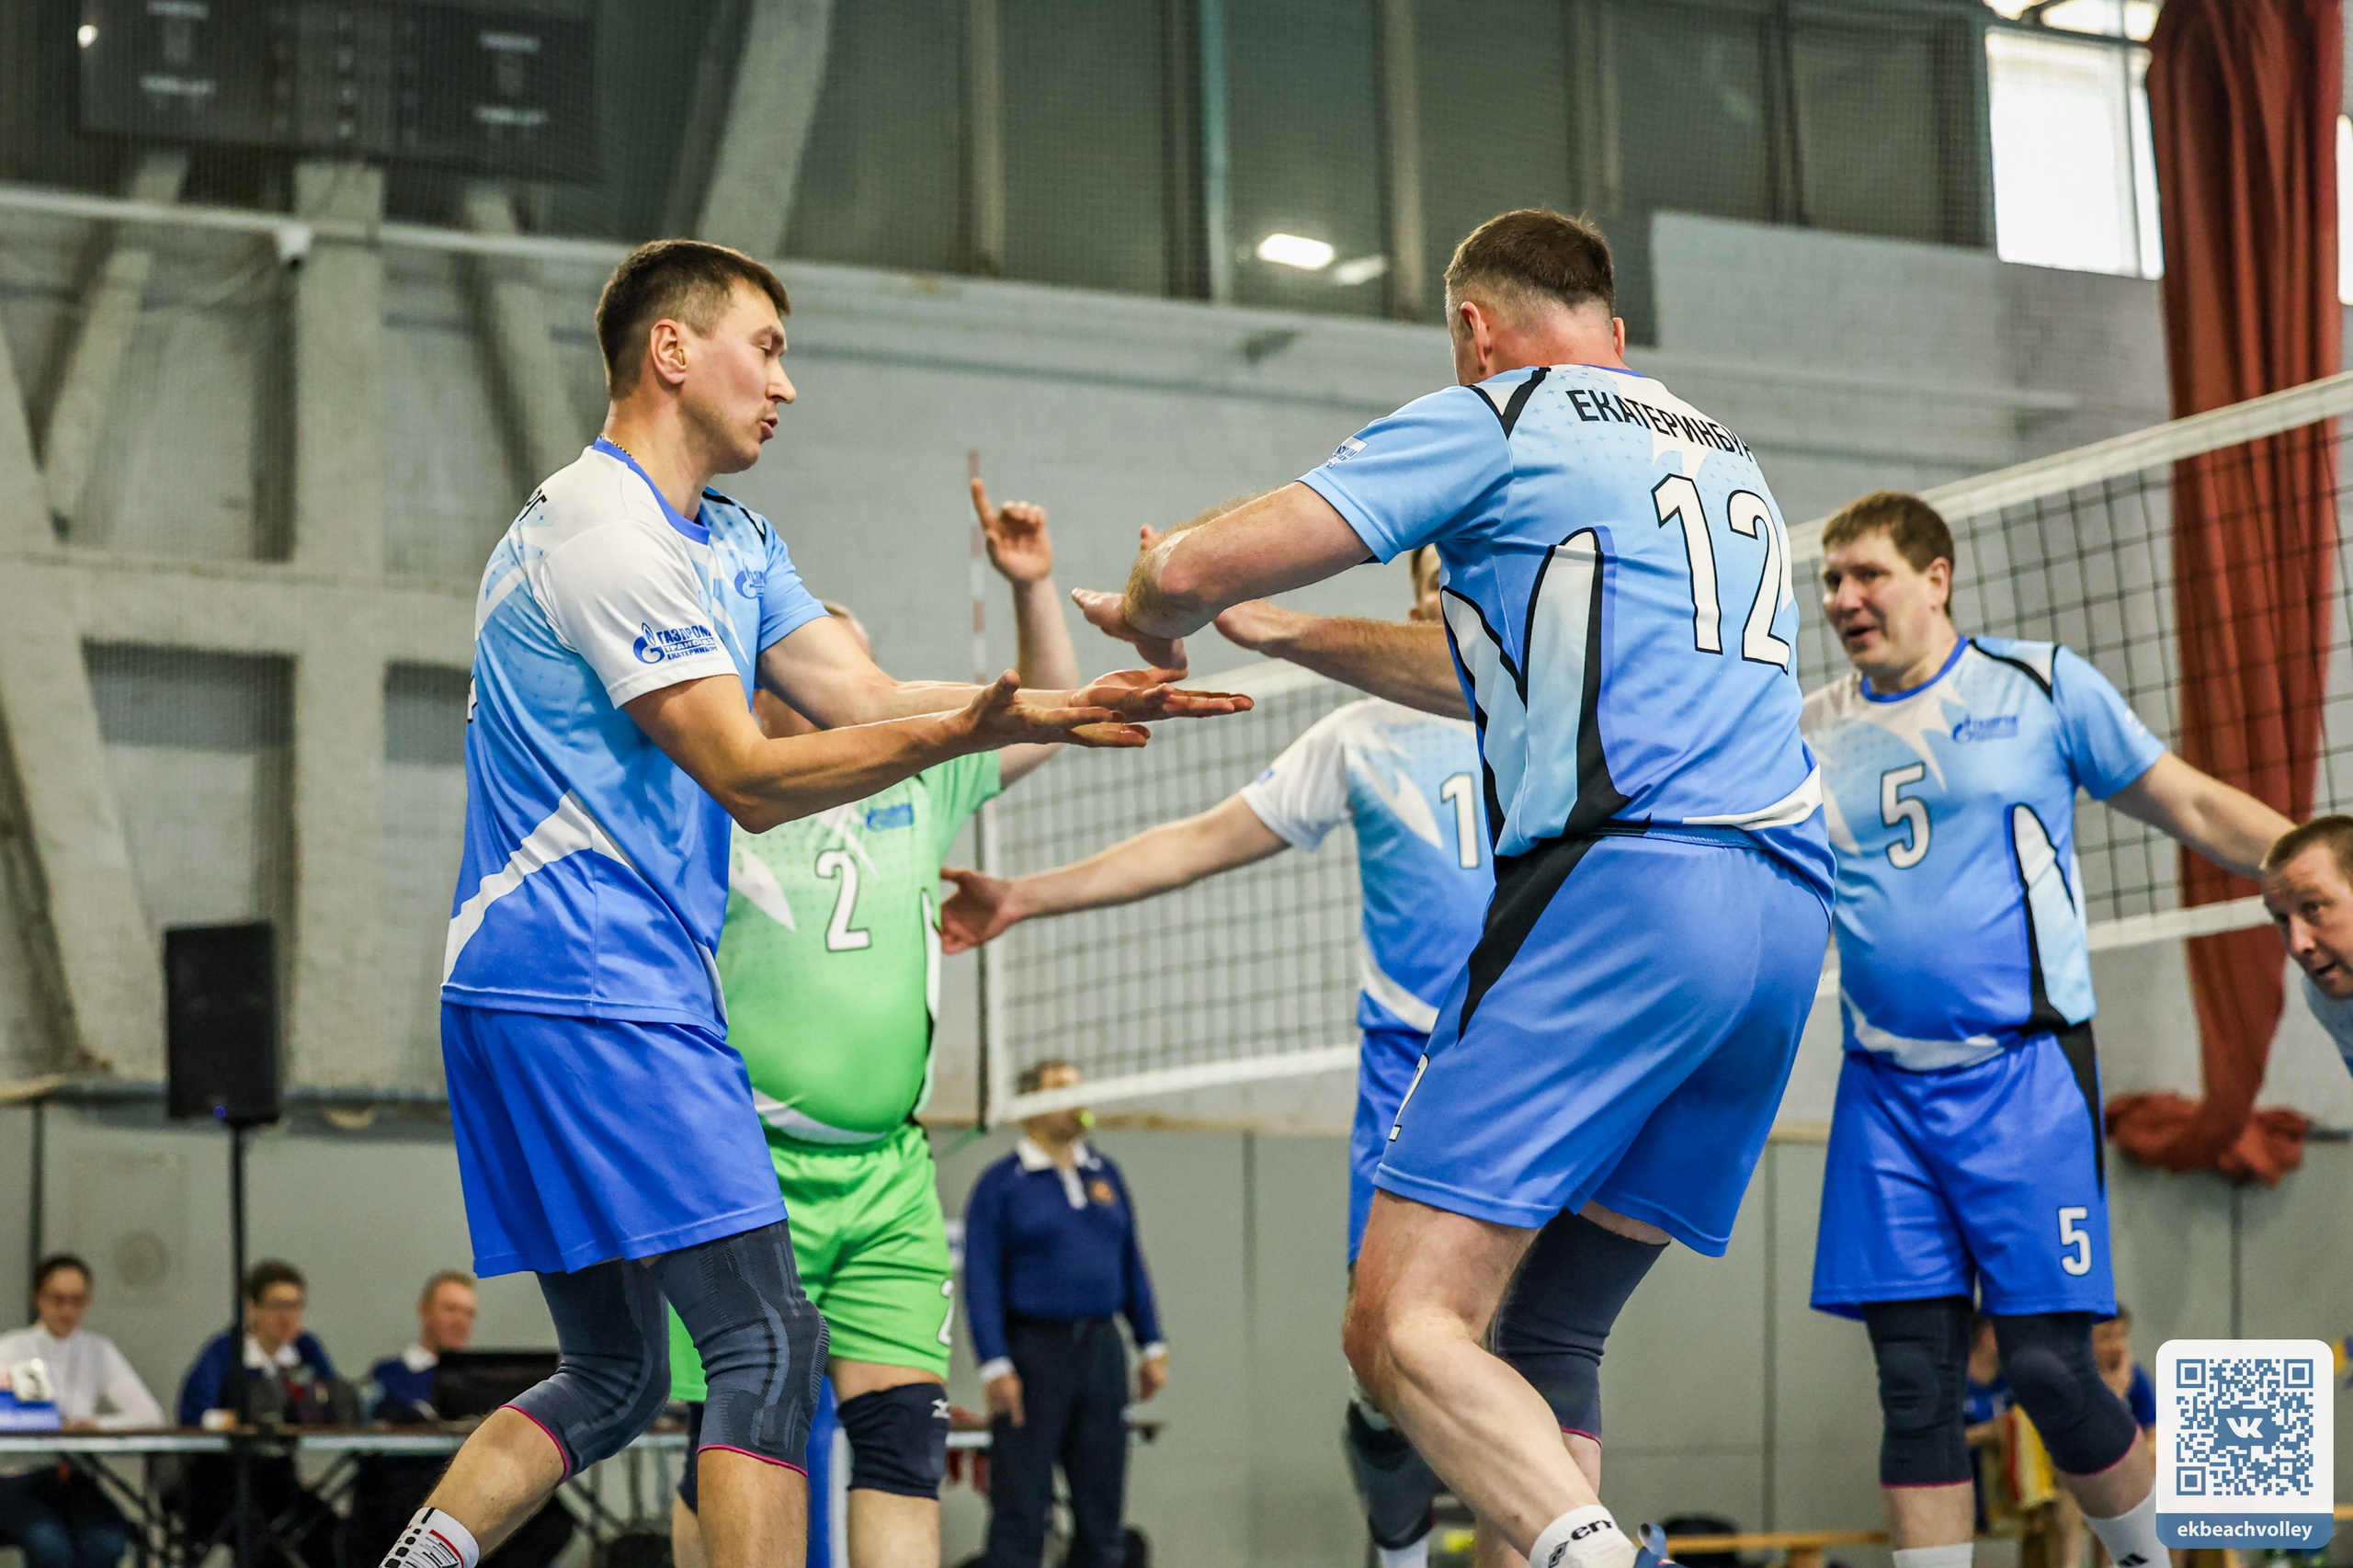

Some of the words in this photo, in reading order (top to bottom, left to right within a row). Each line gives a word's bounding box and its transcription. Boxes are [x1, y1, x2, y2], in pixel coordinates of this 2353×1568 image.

[1651, 472, 1790, 675] 12
[656, 625, 711, 644] ГАЗПРОМ
[1881, 761, 1930, 869] 5
[815, 848, 871, 952] 2
[2058, 1206, 2092, 1277] 5
